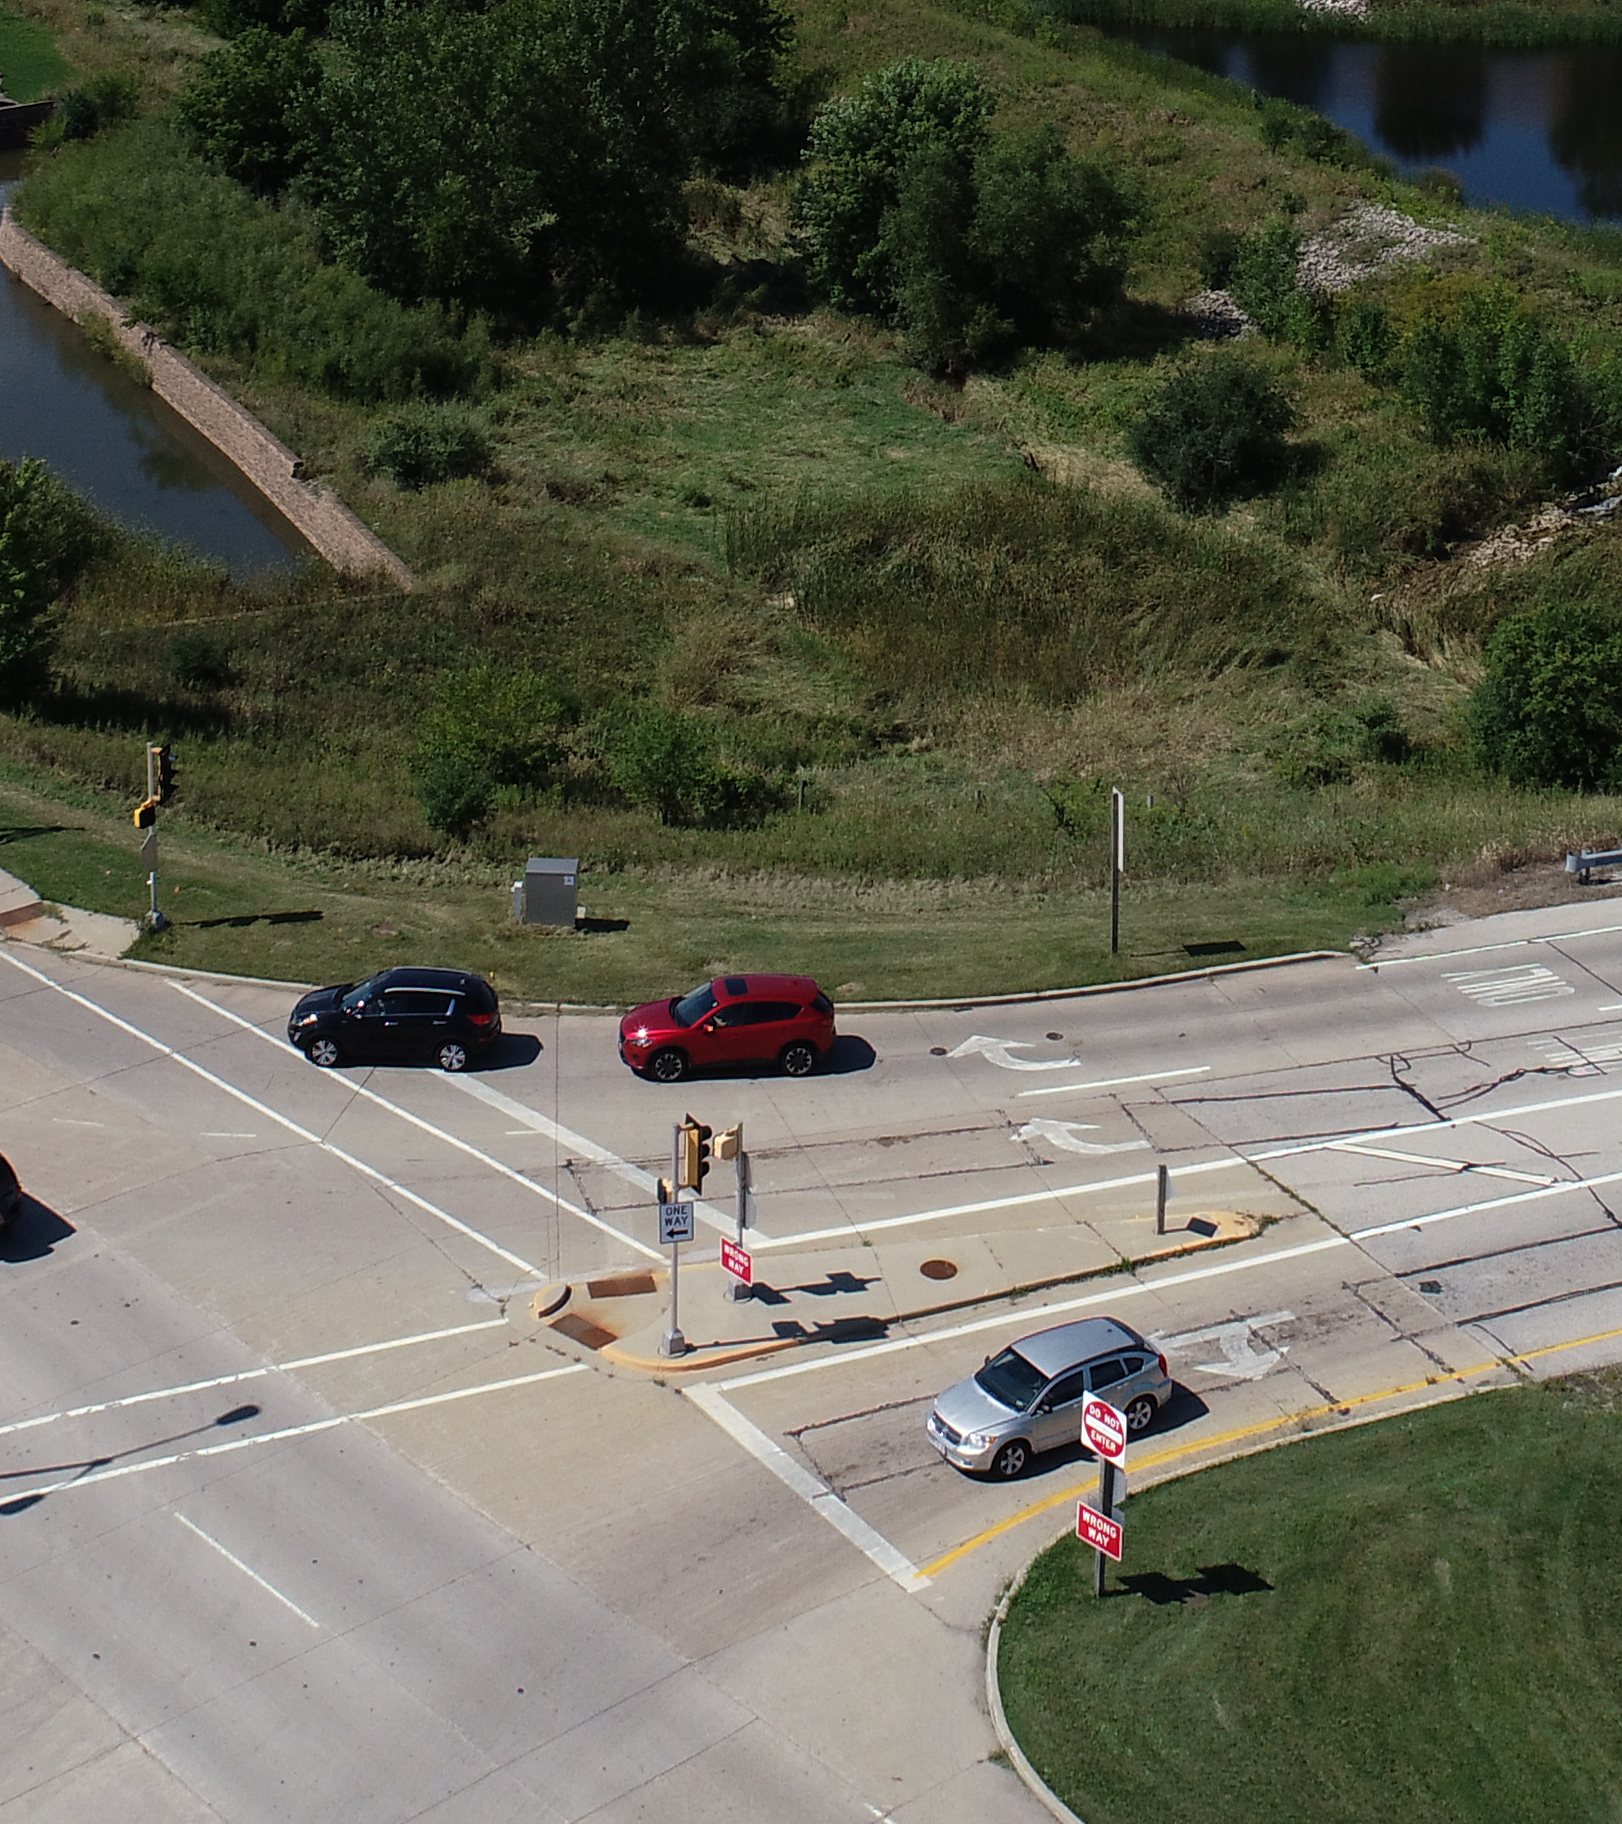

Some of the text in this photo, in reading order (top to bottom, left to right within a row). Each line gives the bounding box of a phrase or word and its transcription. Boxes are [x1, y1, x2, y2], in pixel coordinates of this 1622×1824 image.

[1440, 963, 1575, 1007] ONLY
[665, 1216, 688, 1226] WAY
[666, 1205, 688, 1216] ONE
[724, 1244, 749, 1267] WRONG
[728, 1258, 745, 1275] WAY
[1089, 1404, 1121, 1431] DO NOT
[1090, 1429, 1116, 1453] ENTER
[1082, 1509, 1117, 1539] WRONG
[1088, 1527, 1110, 1547] WAY
